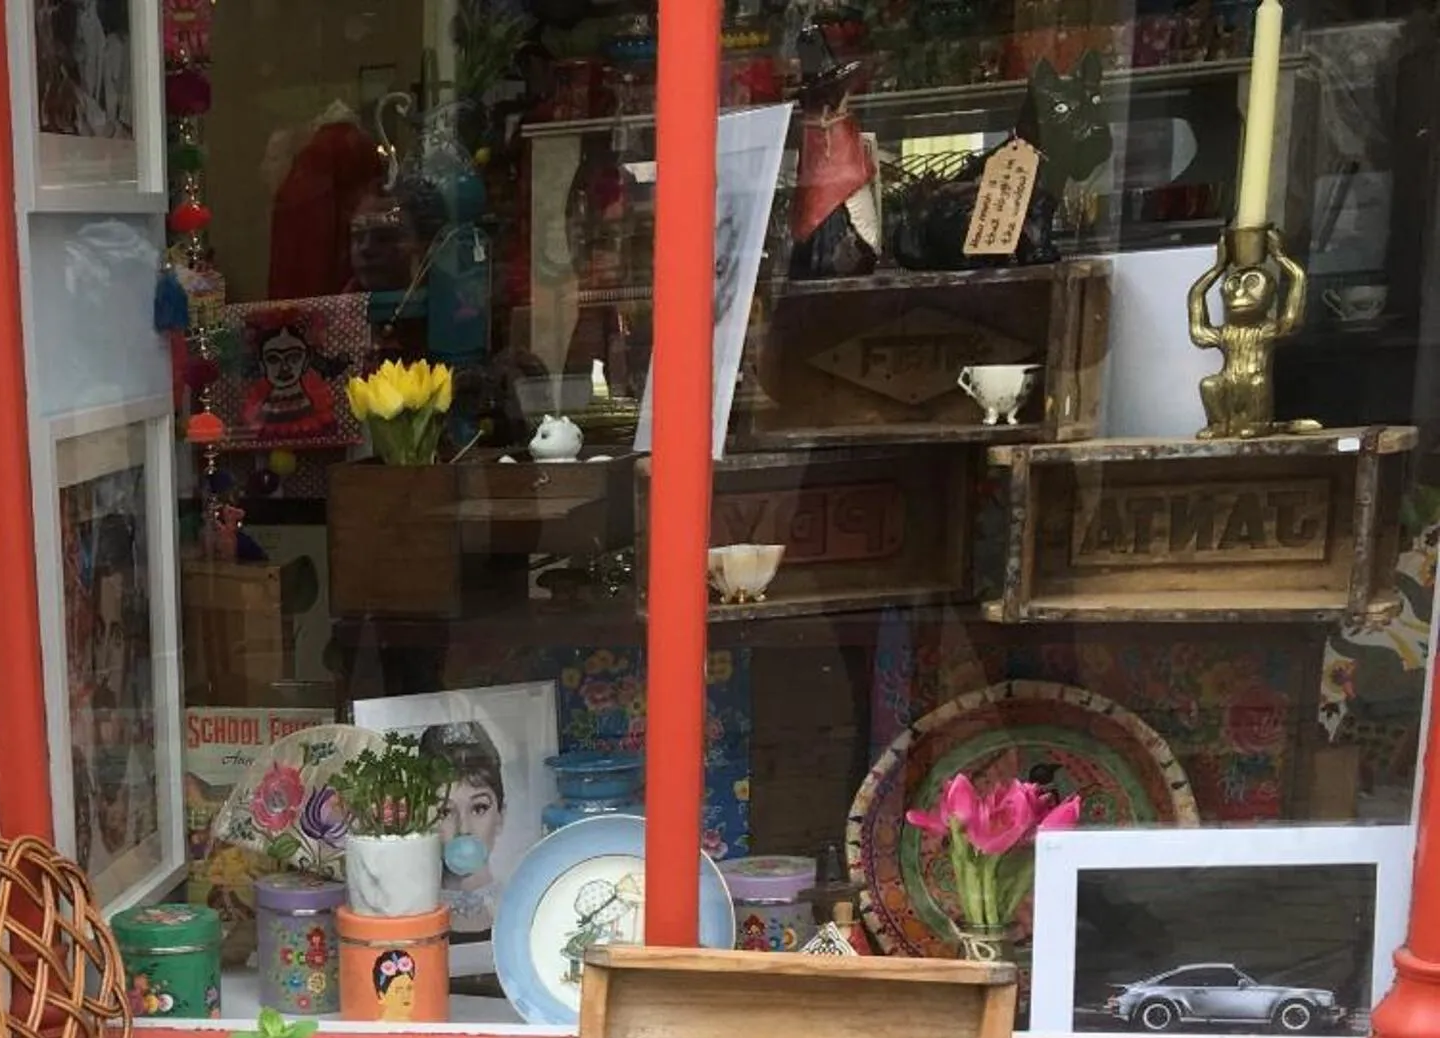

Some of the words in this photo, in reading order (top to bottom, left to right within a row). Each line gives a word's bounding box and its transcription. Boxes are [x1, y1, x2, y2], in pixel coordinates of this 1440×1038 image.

[985, 217, 1000, 246] that
[1000, 221, 1016, 246] the
[188, 714, 264, 748] SCHOOL
